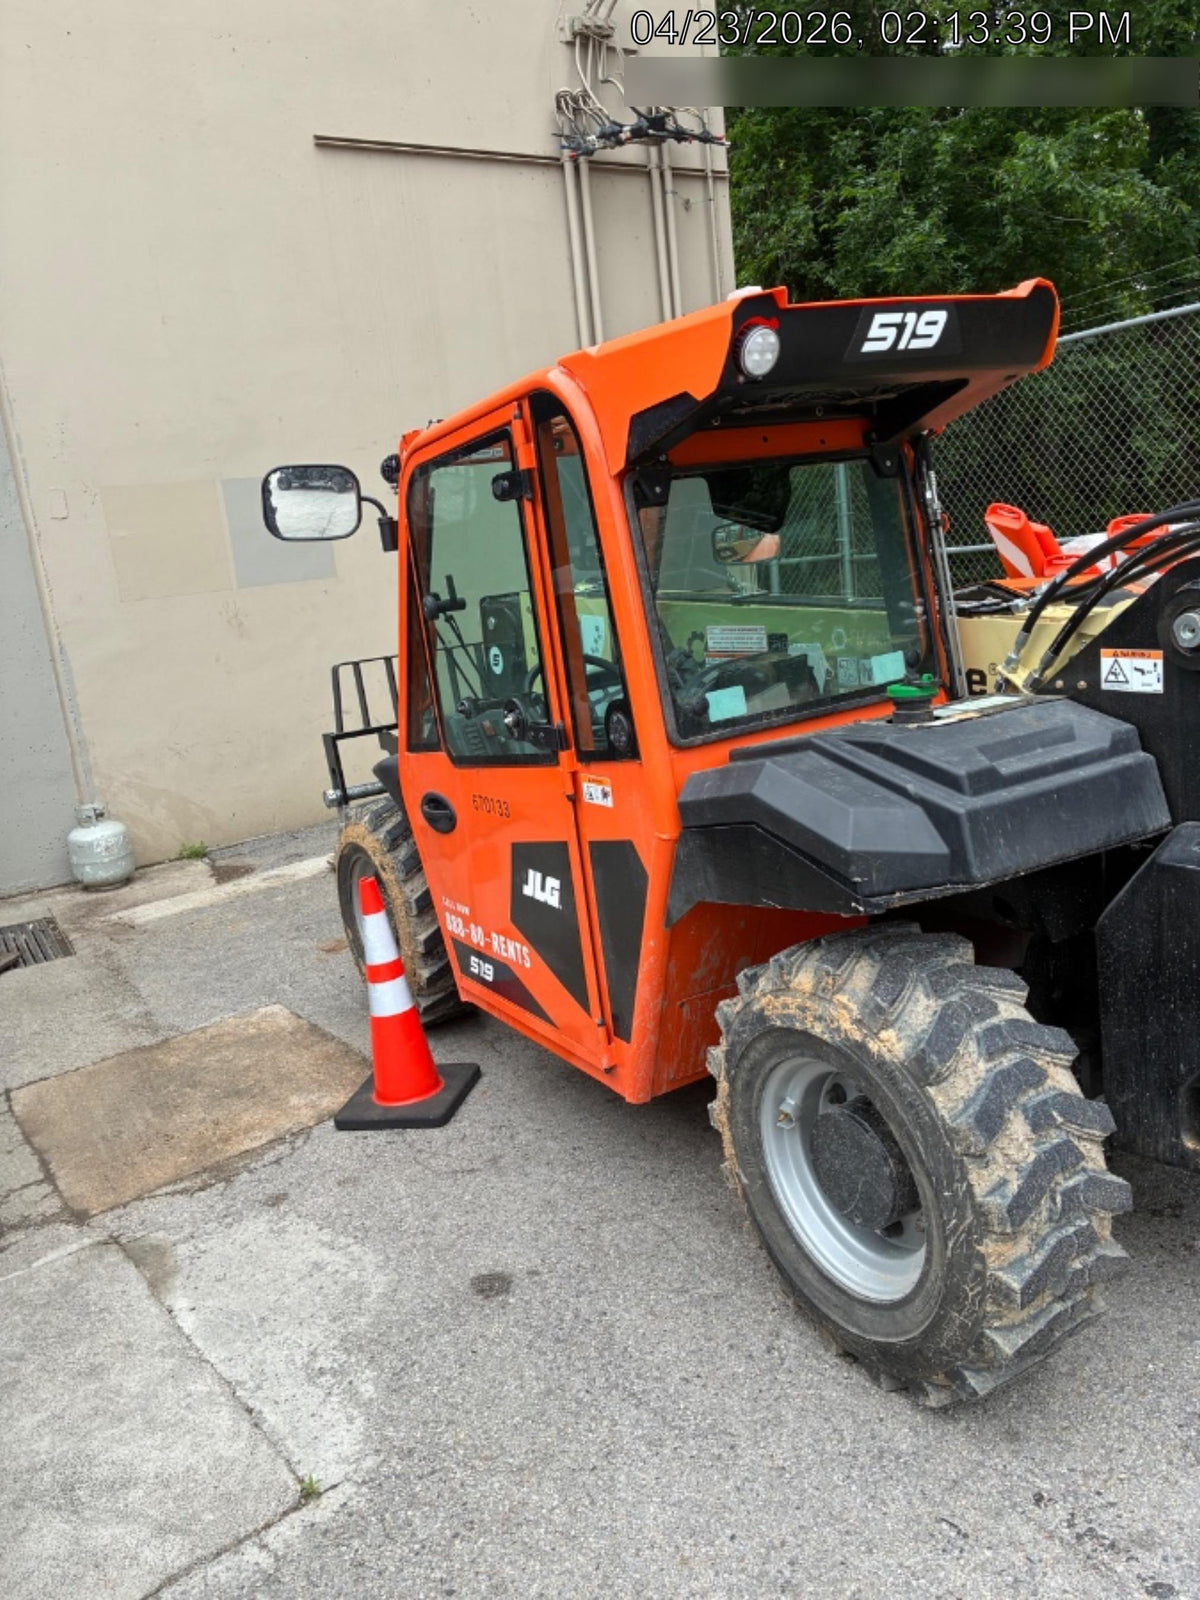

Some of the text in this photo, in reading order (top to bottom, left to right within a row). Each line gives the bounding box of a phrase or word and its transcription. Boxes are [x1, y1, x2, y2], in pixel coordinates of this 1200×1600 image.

[860, 310, 948, 353] 519
[522, 868, 561, 908] JLG
[469, 955, 494, 982] 519
